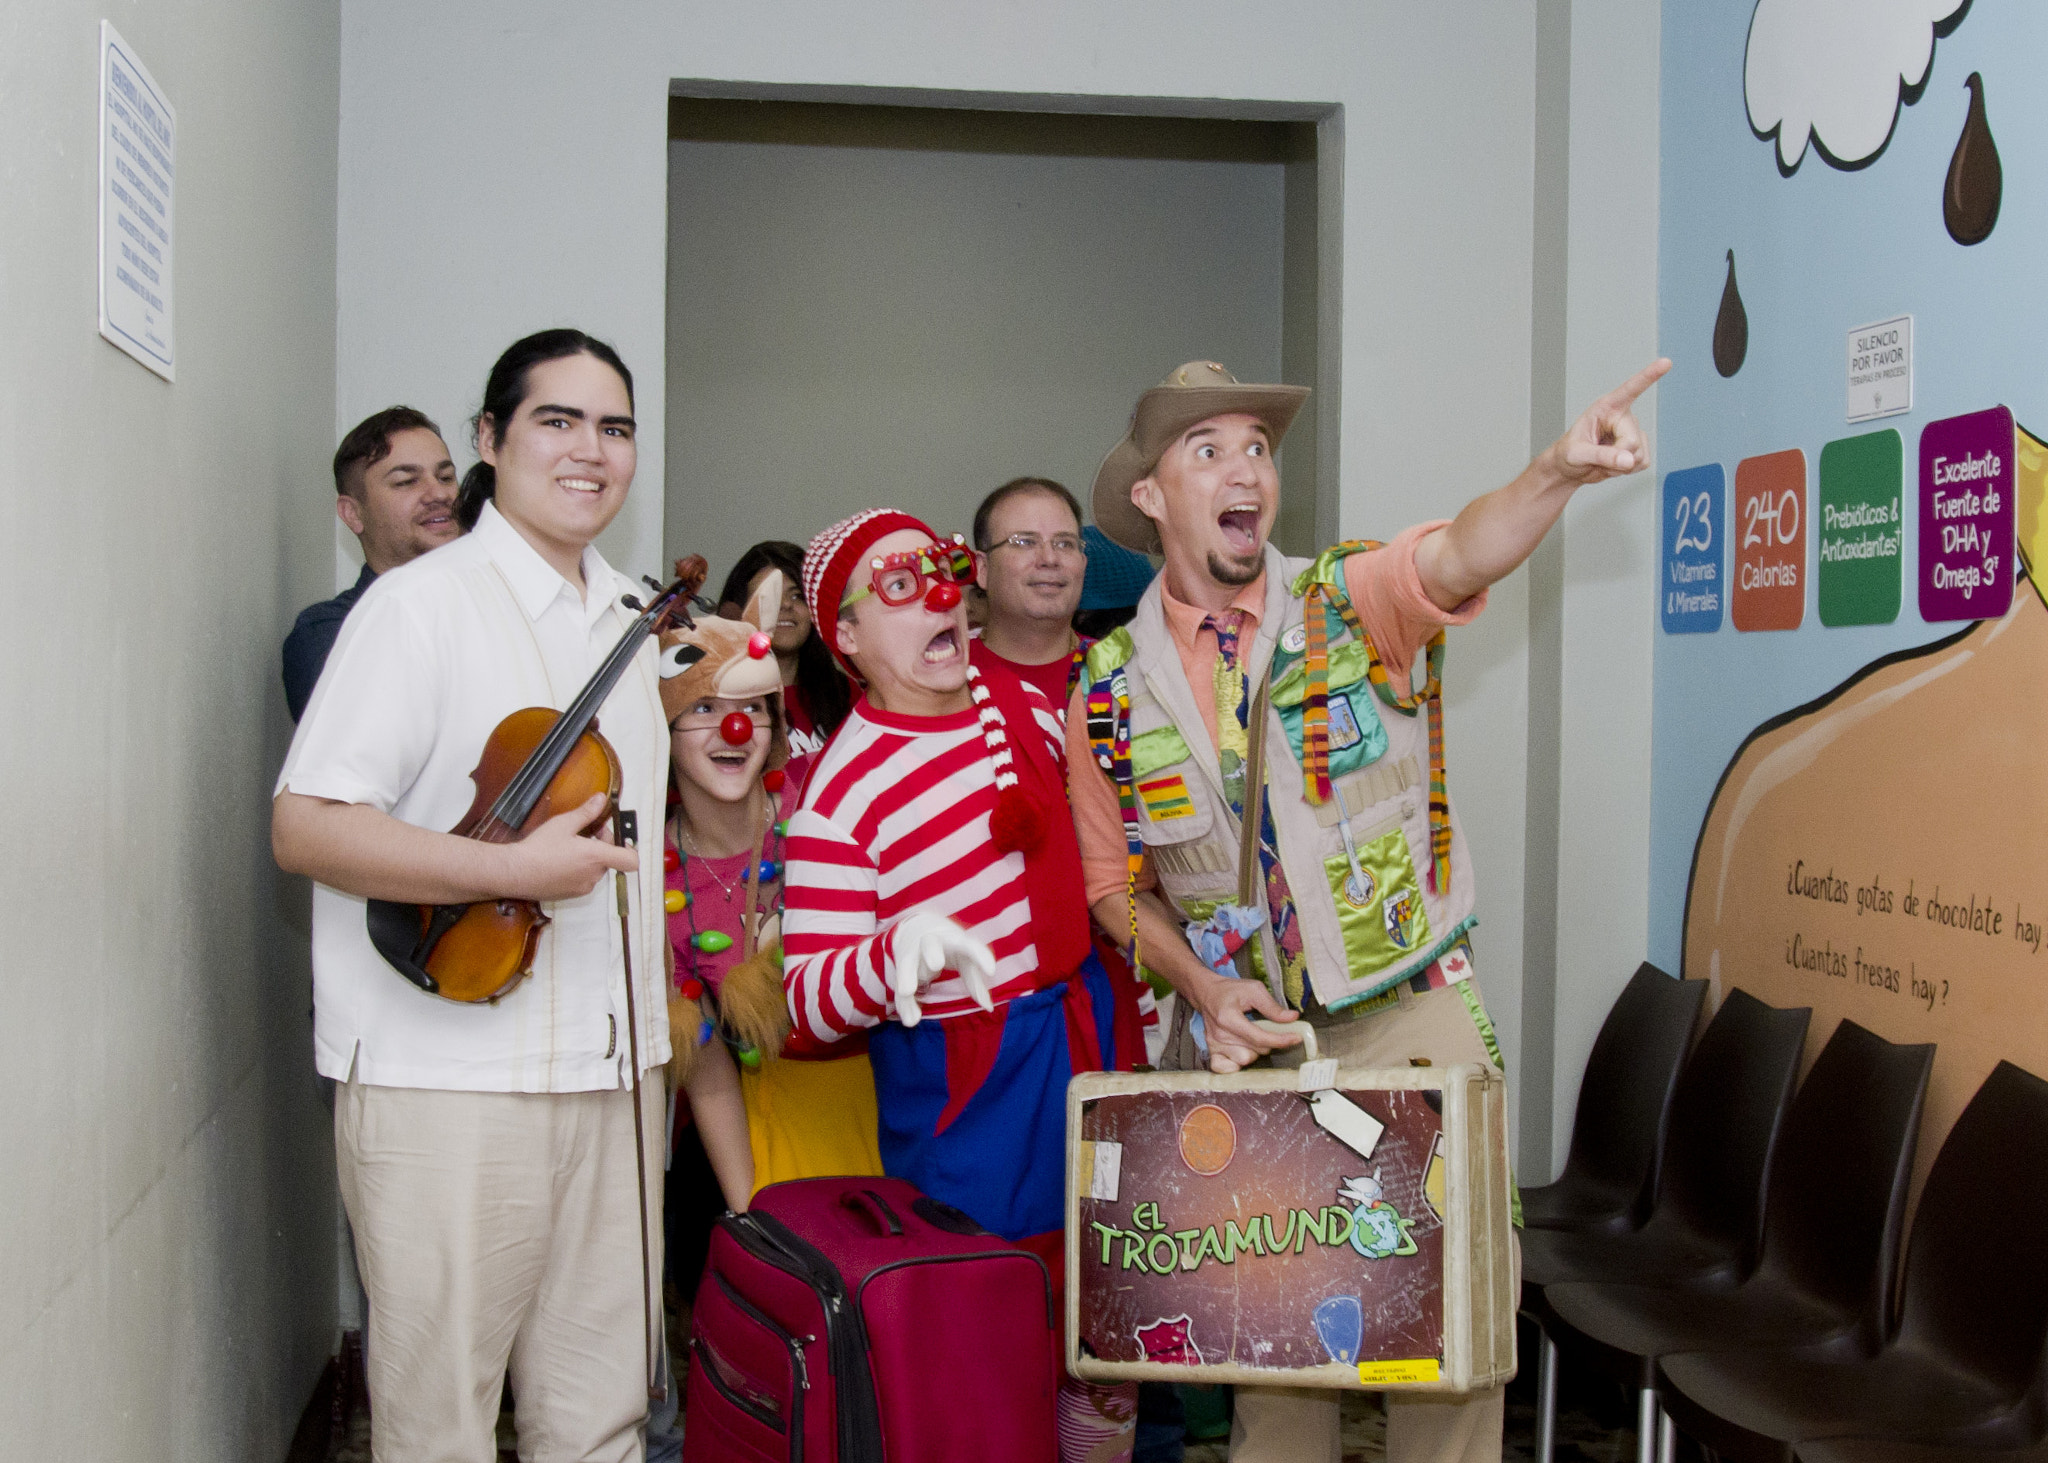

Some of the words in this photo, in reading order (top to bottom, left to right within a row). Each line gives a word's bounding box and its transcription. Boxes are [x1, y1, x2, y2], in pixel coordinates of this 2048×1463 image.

[1852, 355, 1871, 371] POR
[1873, 347, 1904, 368] FAVOR
[1857, 330, 1898, 353] SILENCIO
[1850, 373, 1874, 386] TERAPIAS
[1874, 371, 1882, 381] EN
[1883, 366, 1907, 379] PROCESO
[1933, 449, 2001, 486] Excelente
[1743, 489, 1799, 550] 240
[1824, 502, 1889, 531] Prebióticos
[1890, 496, 1899, 522] &
[1933, 488, 1980, 520] Fuente
[1983, 483, 2001, 515] de
[1675, 491, 1712, 555] 23
[1942, 523, 1979, 554] DHA
[1981, 529, 1992, 558] y
[1670, 561, 1717, 584] Vitaminas
[1933, 562, 1980, 600] Omega
[1667, 592, 1674, 615] &
[1675, 586, 1719, 614] Minerales
[1857, 874, 1894, 916] gotas
[1903, 878, 1920, 917] de
[1926, 885, 2002, 936] chocolate
[2015, 902, 2048, 954] hay
[1854, 946, 1900, 994] fresas
[1131, 1201, 1167, 1231] EL
[1090, 1199, 1419, 1276] TROTAMUNDOS
